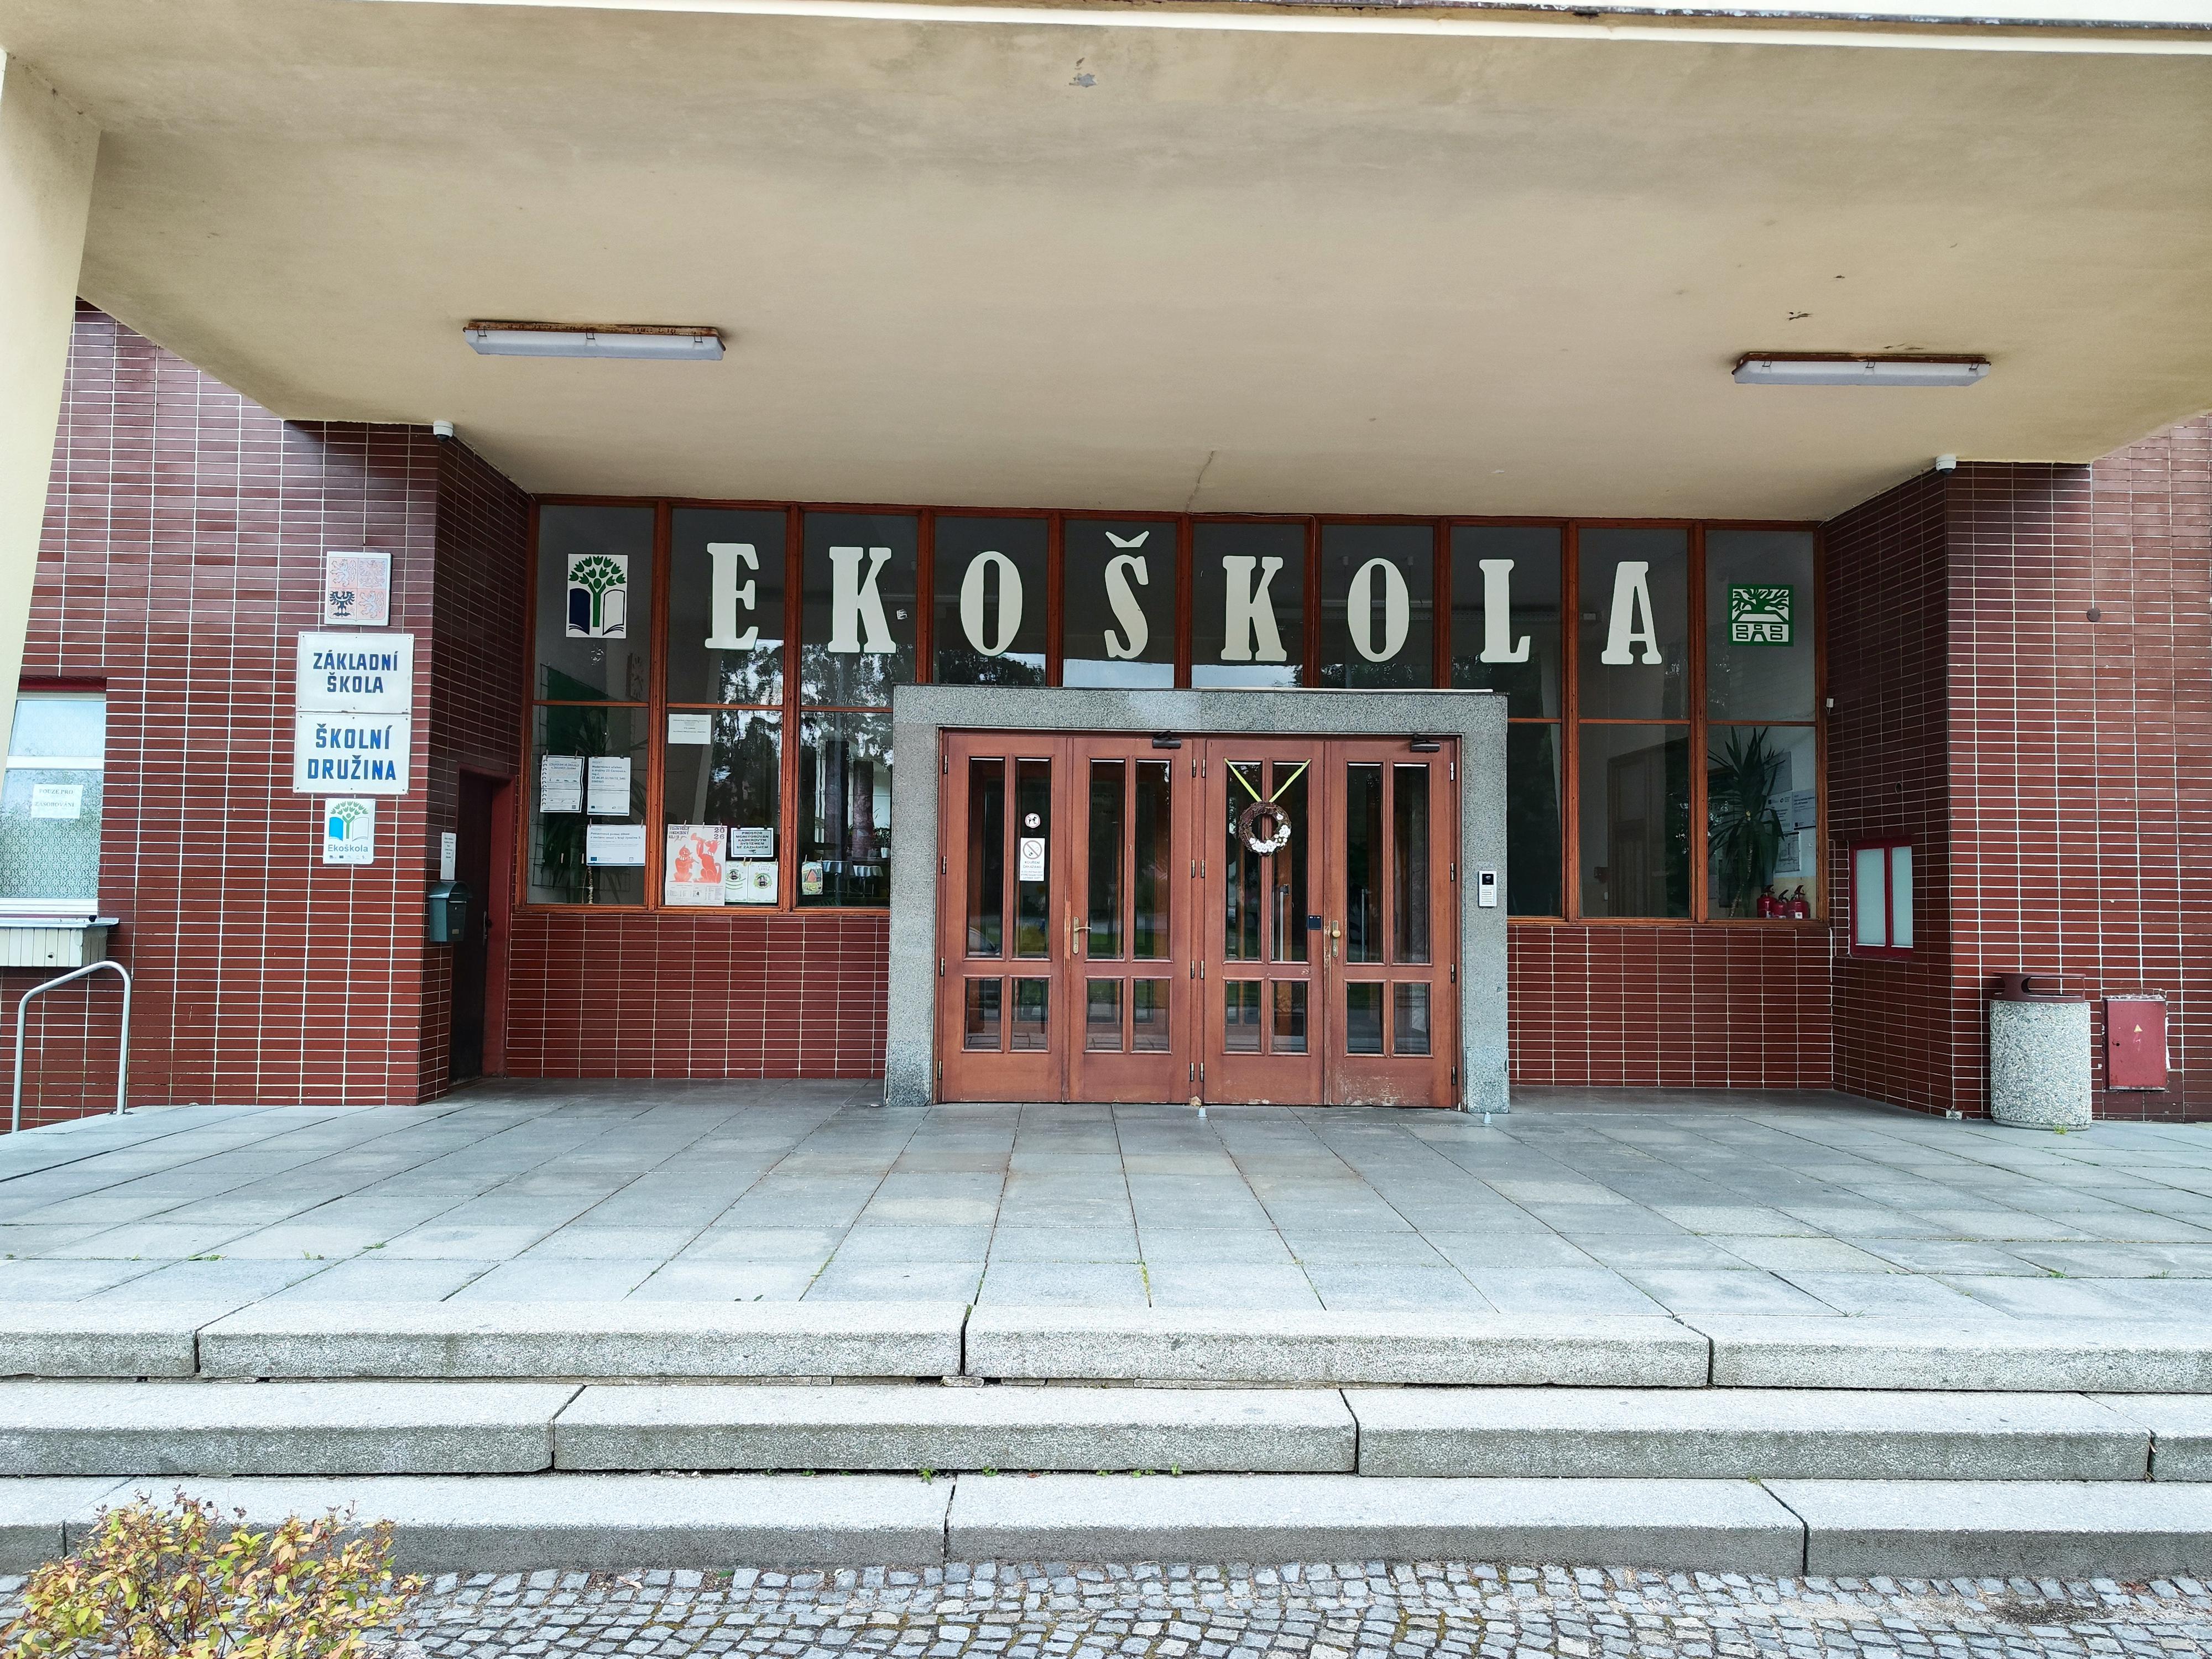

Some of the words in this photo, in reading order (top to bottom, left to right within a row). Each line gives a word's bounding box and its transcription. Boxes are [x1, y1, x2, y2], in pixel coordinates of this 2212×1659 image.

[312, 649, 399, 671] ZÁKLADNÍ
[327, 671, 384, 693] ŠKOLA
[315, 723, 393, 750] ŠKOLNÍ
[307, 754, 397, 780] DRUŽINA
[327, 844, 368, 852] Ekoškola
